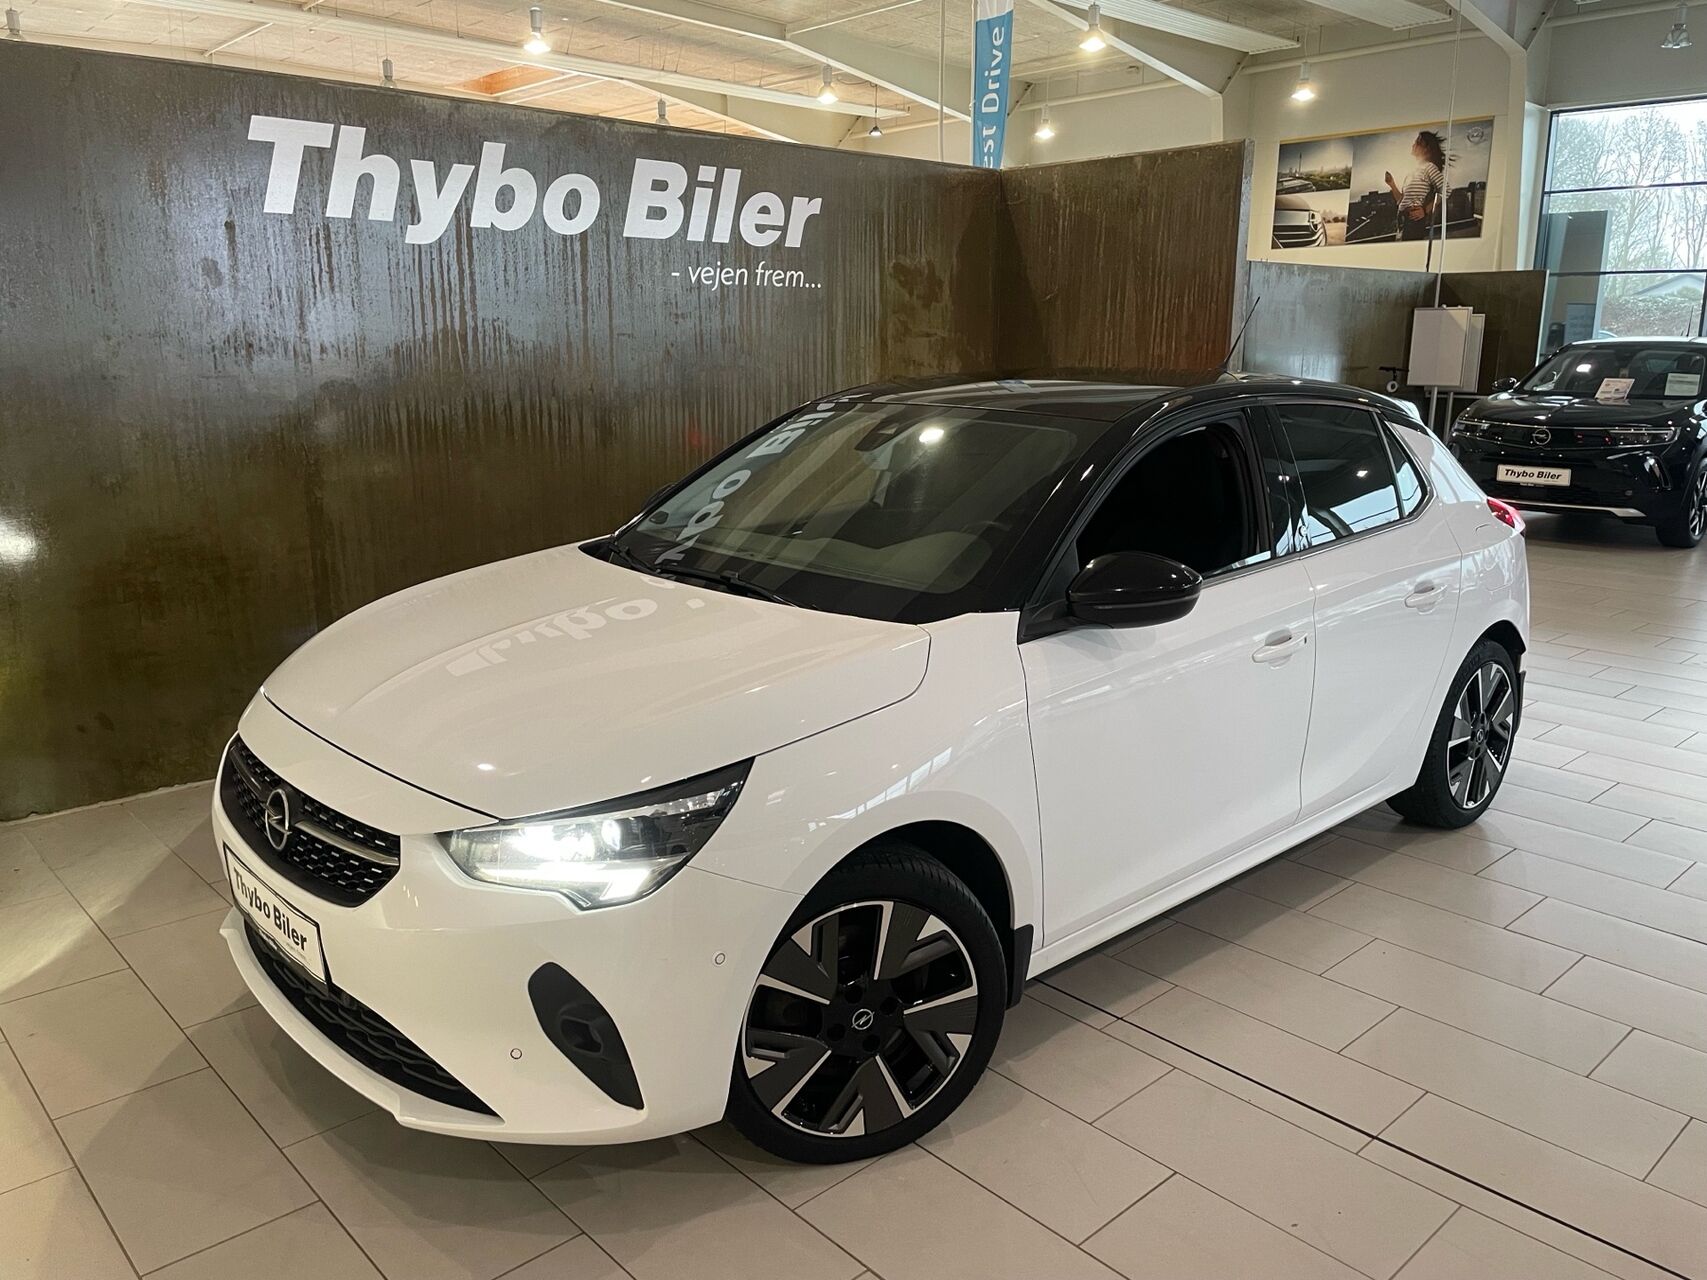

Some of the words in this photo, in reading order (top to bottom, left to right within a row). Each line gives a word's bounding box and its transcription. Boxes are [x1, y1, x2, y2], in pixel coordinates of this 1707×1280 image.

[981, 26, 1005, 113] Drive
[247, 114, 601, 245] Thybo
[622, 157, 823, 249] Biler
[687, 261, 749, 292] vejen
[755, 260, 823, 290] frem...
[1504, 468, 1535, 479] Thybo
[1536, 470, 1563, 480] Biler
[233, 866, 271, 919] Thybo
[272, 904, 308, 951] Biler
